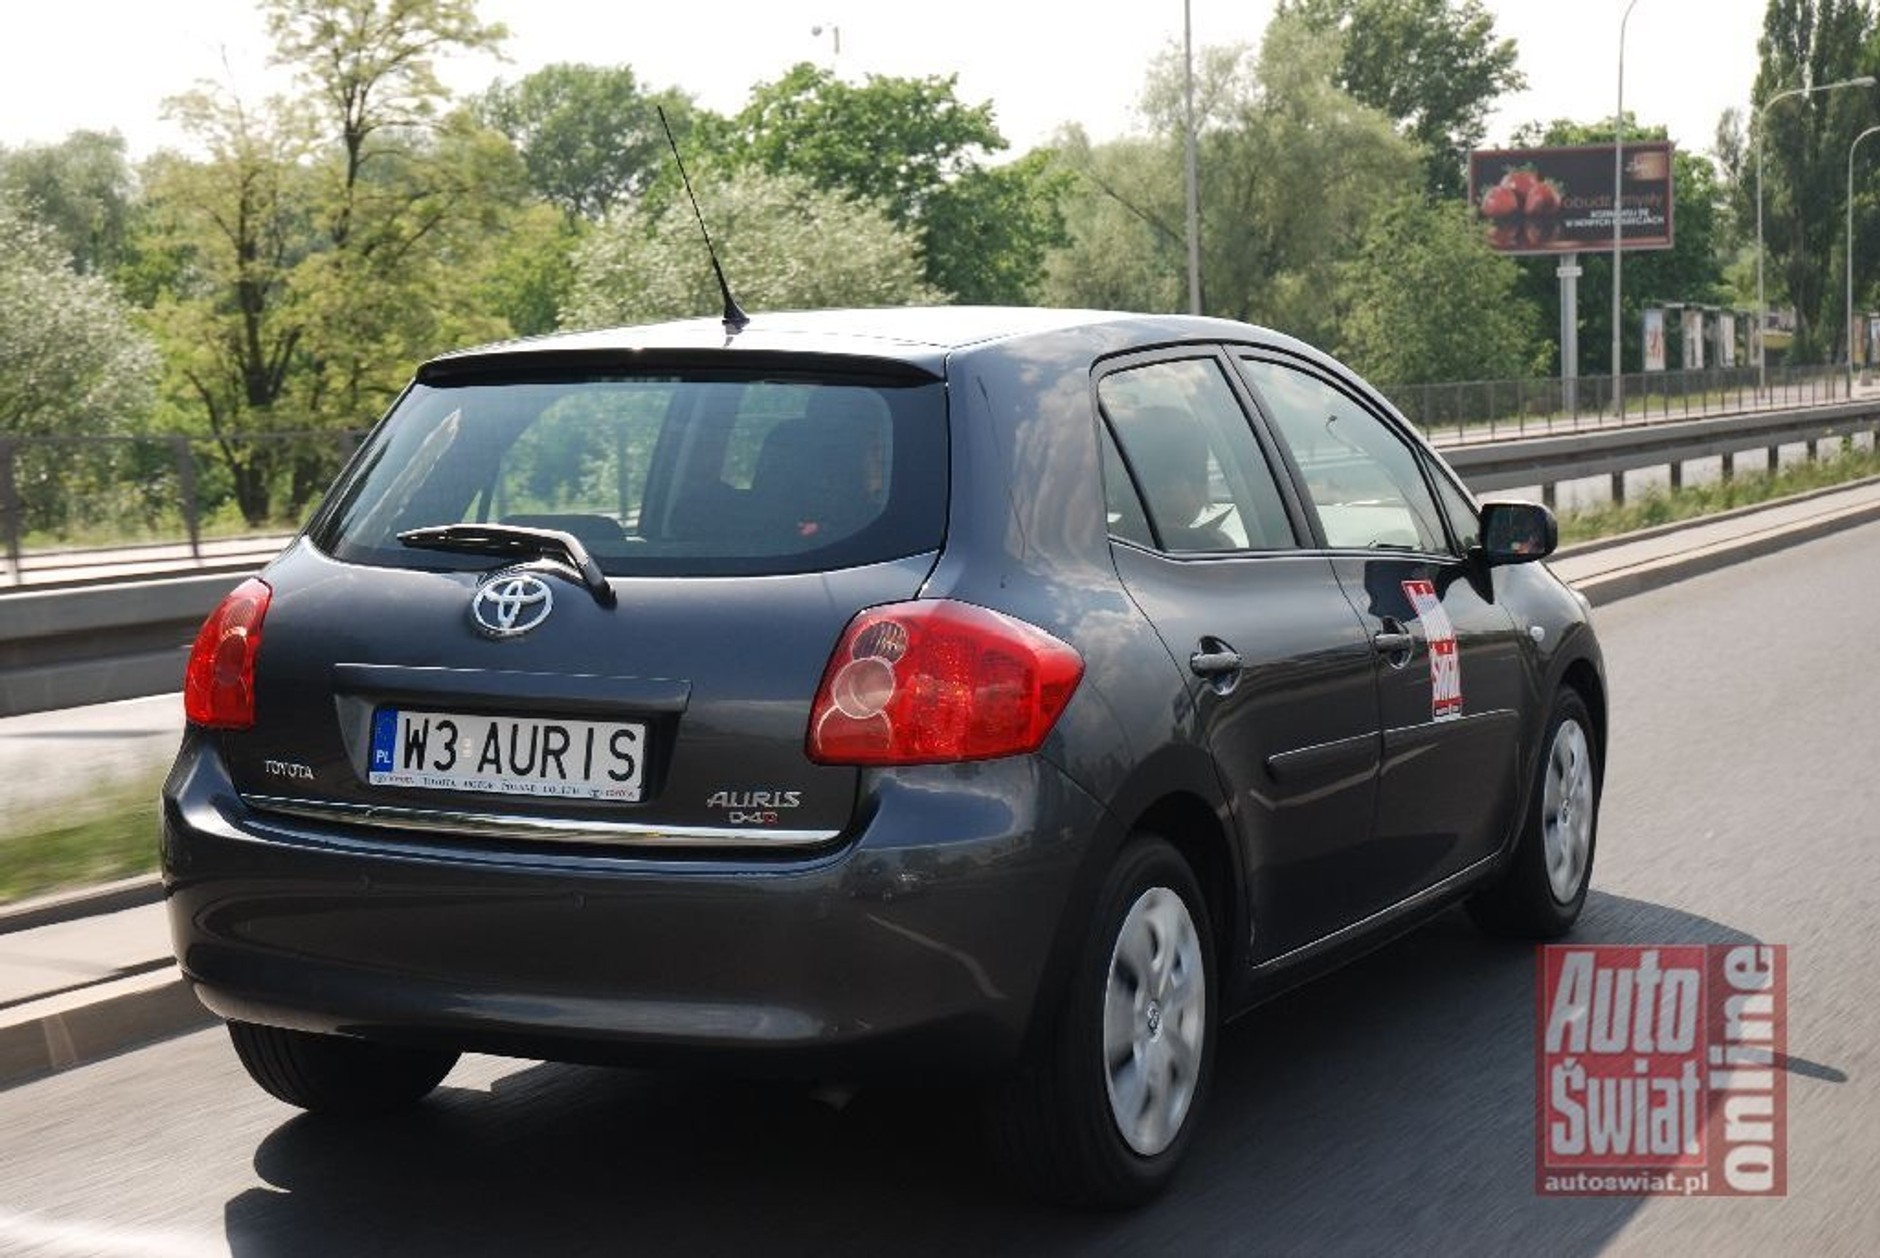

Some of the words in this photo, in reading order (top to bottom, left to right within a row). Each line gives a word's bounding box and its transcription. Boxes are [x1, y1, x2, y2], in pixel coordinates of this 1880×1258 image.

[375, 750, 392, 764] PL
[403, 717, 459, 772] W3
[477, 721, 637, 783] AURIS
[264, 760, 314, 780] TOYOTA
[706, 791, 802, 808] AURIS
